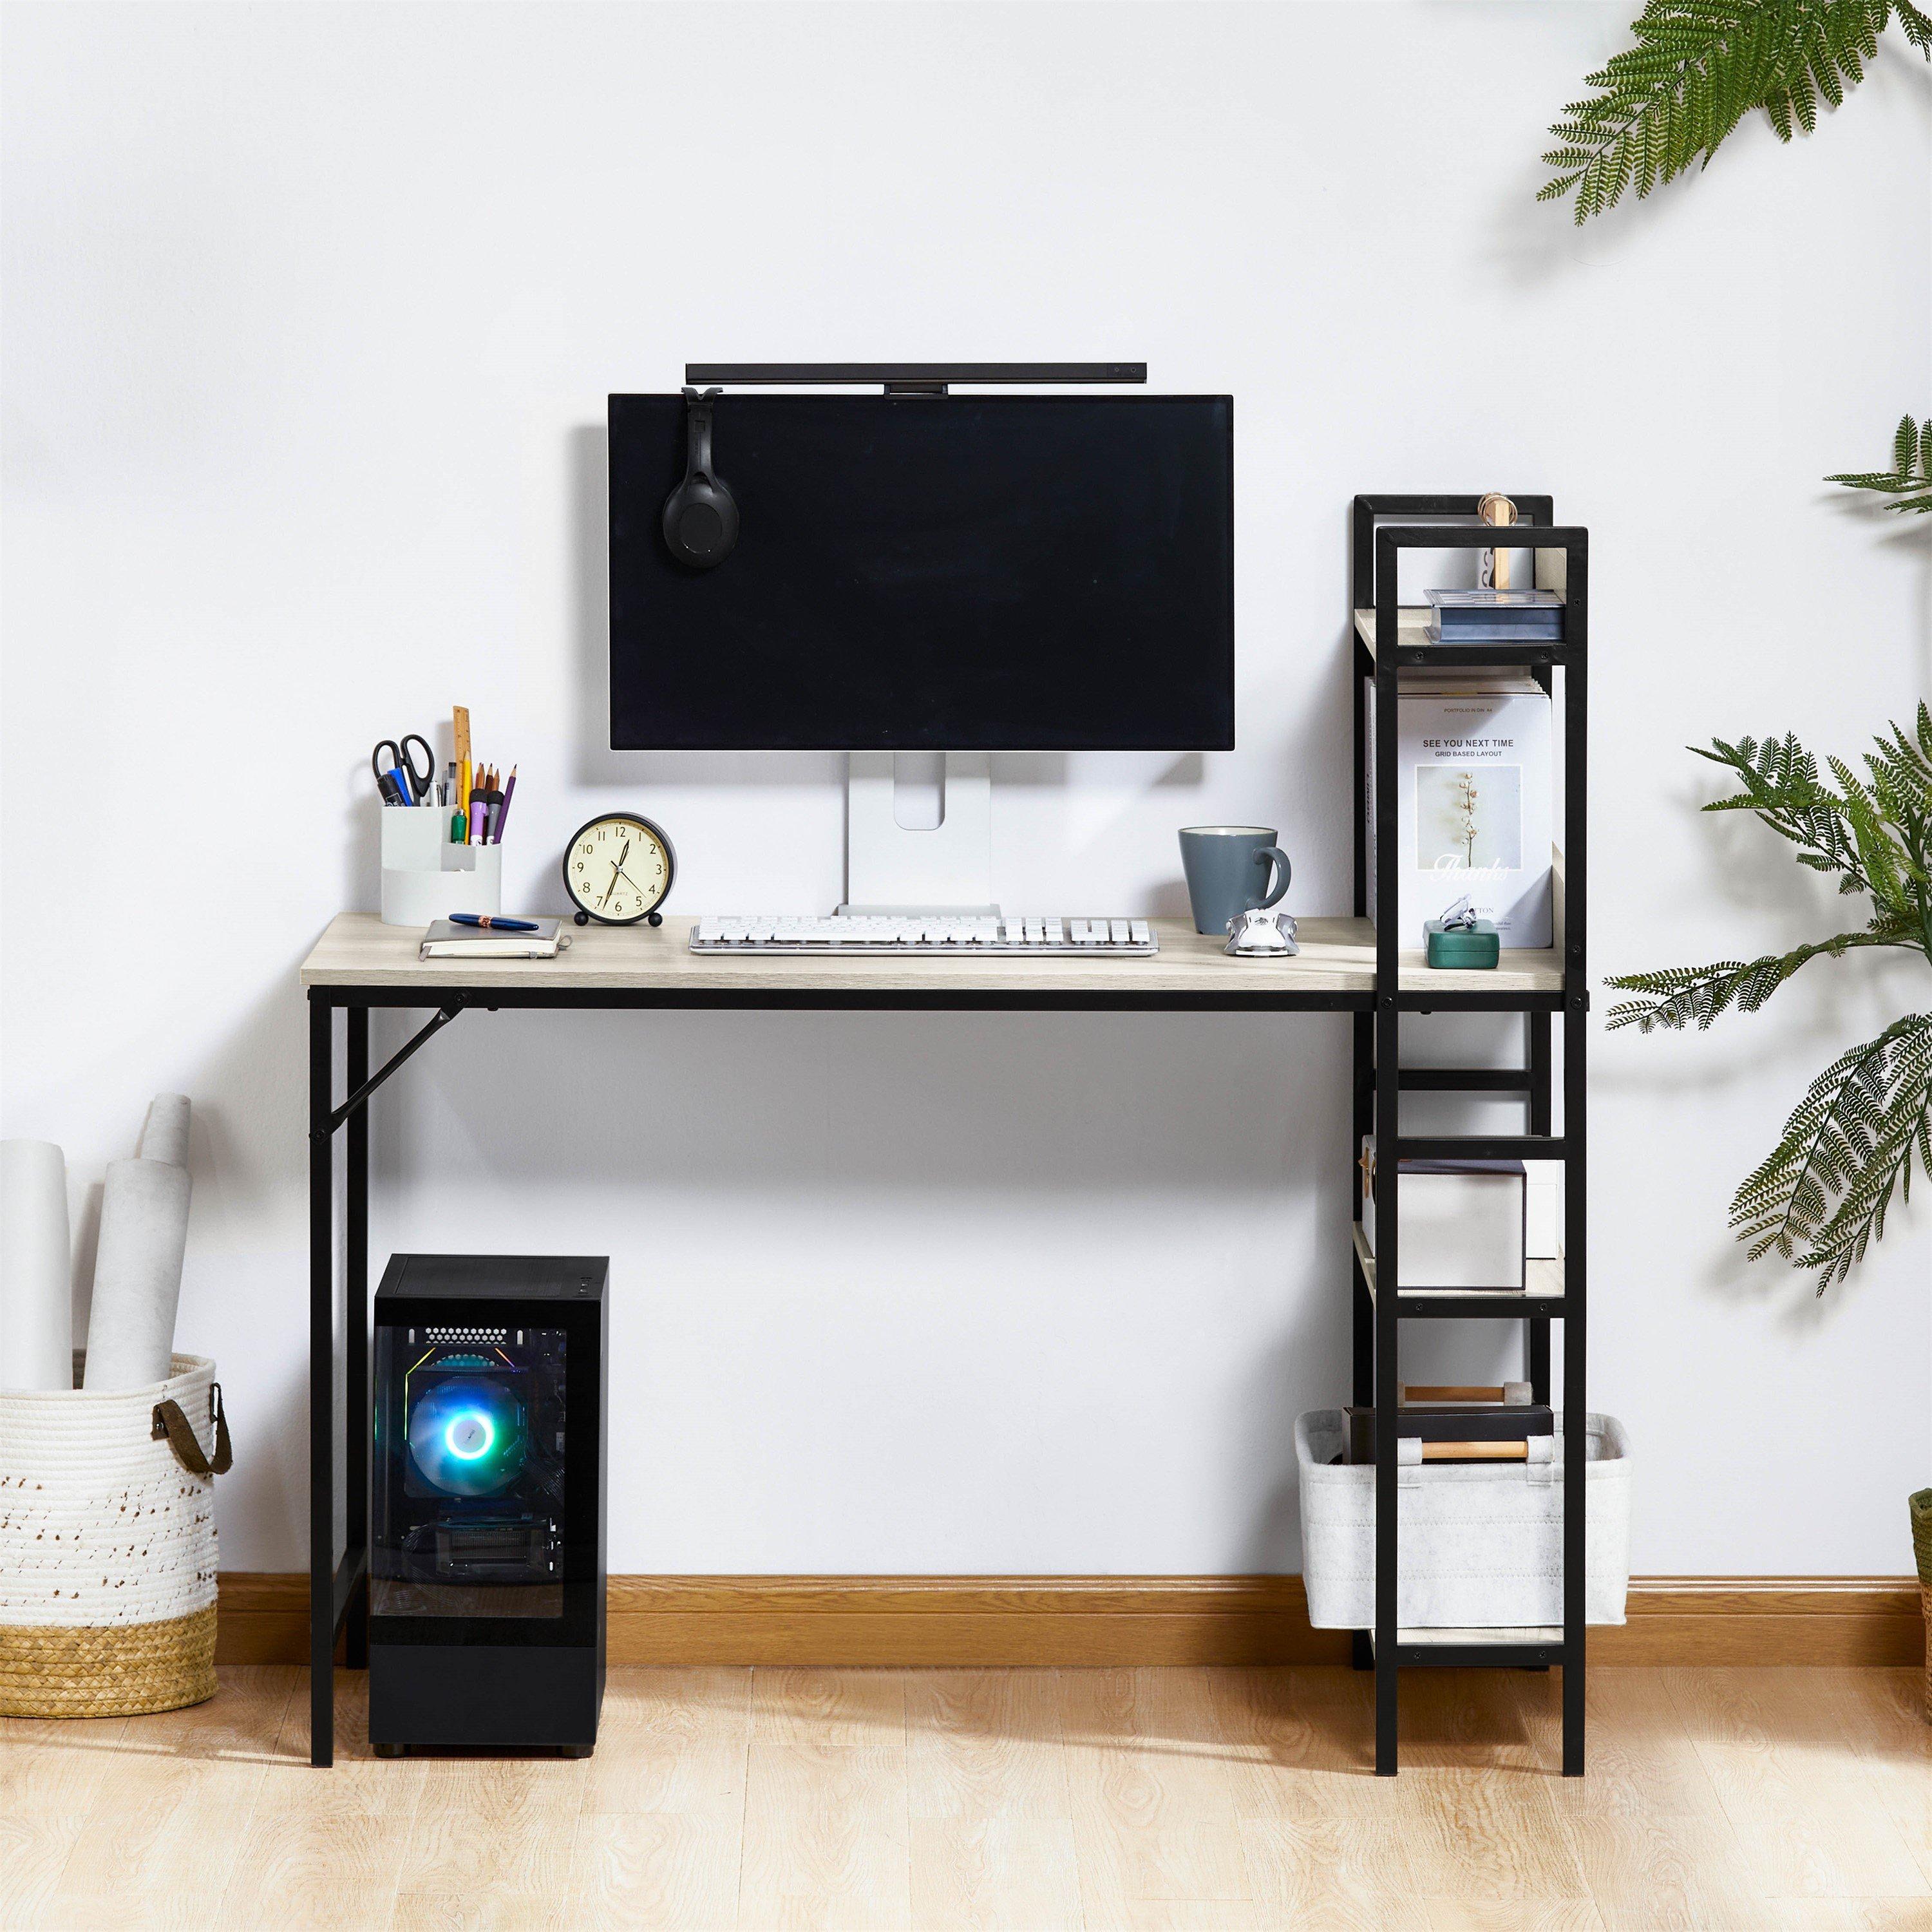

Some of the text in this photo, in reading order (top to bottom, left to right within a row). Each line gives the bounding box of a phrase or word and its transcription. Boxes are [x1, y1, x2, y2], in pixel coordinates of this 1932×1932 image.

[598, 831, 605, 841] 11
[616, 826, 626, 837] 12
[583, 844, 593, 855] 10
[650, 844, 656, 854] 2
[578, 862, 583, 872] 9
[656, 864, 661, 875] 3
[1430, 854, 1510, 881] Thanks
[583, 882, 590, 893] 8
[649, 884, 655, 894] 4
[597, 896, 603, 906] 7
[636, 896, 641, 906] 5
[615, 902, 621, 911] 6
